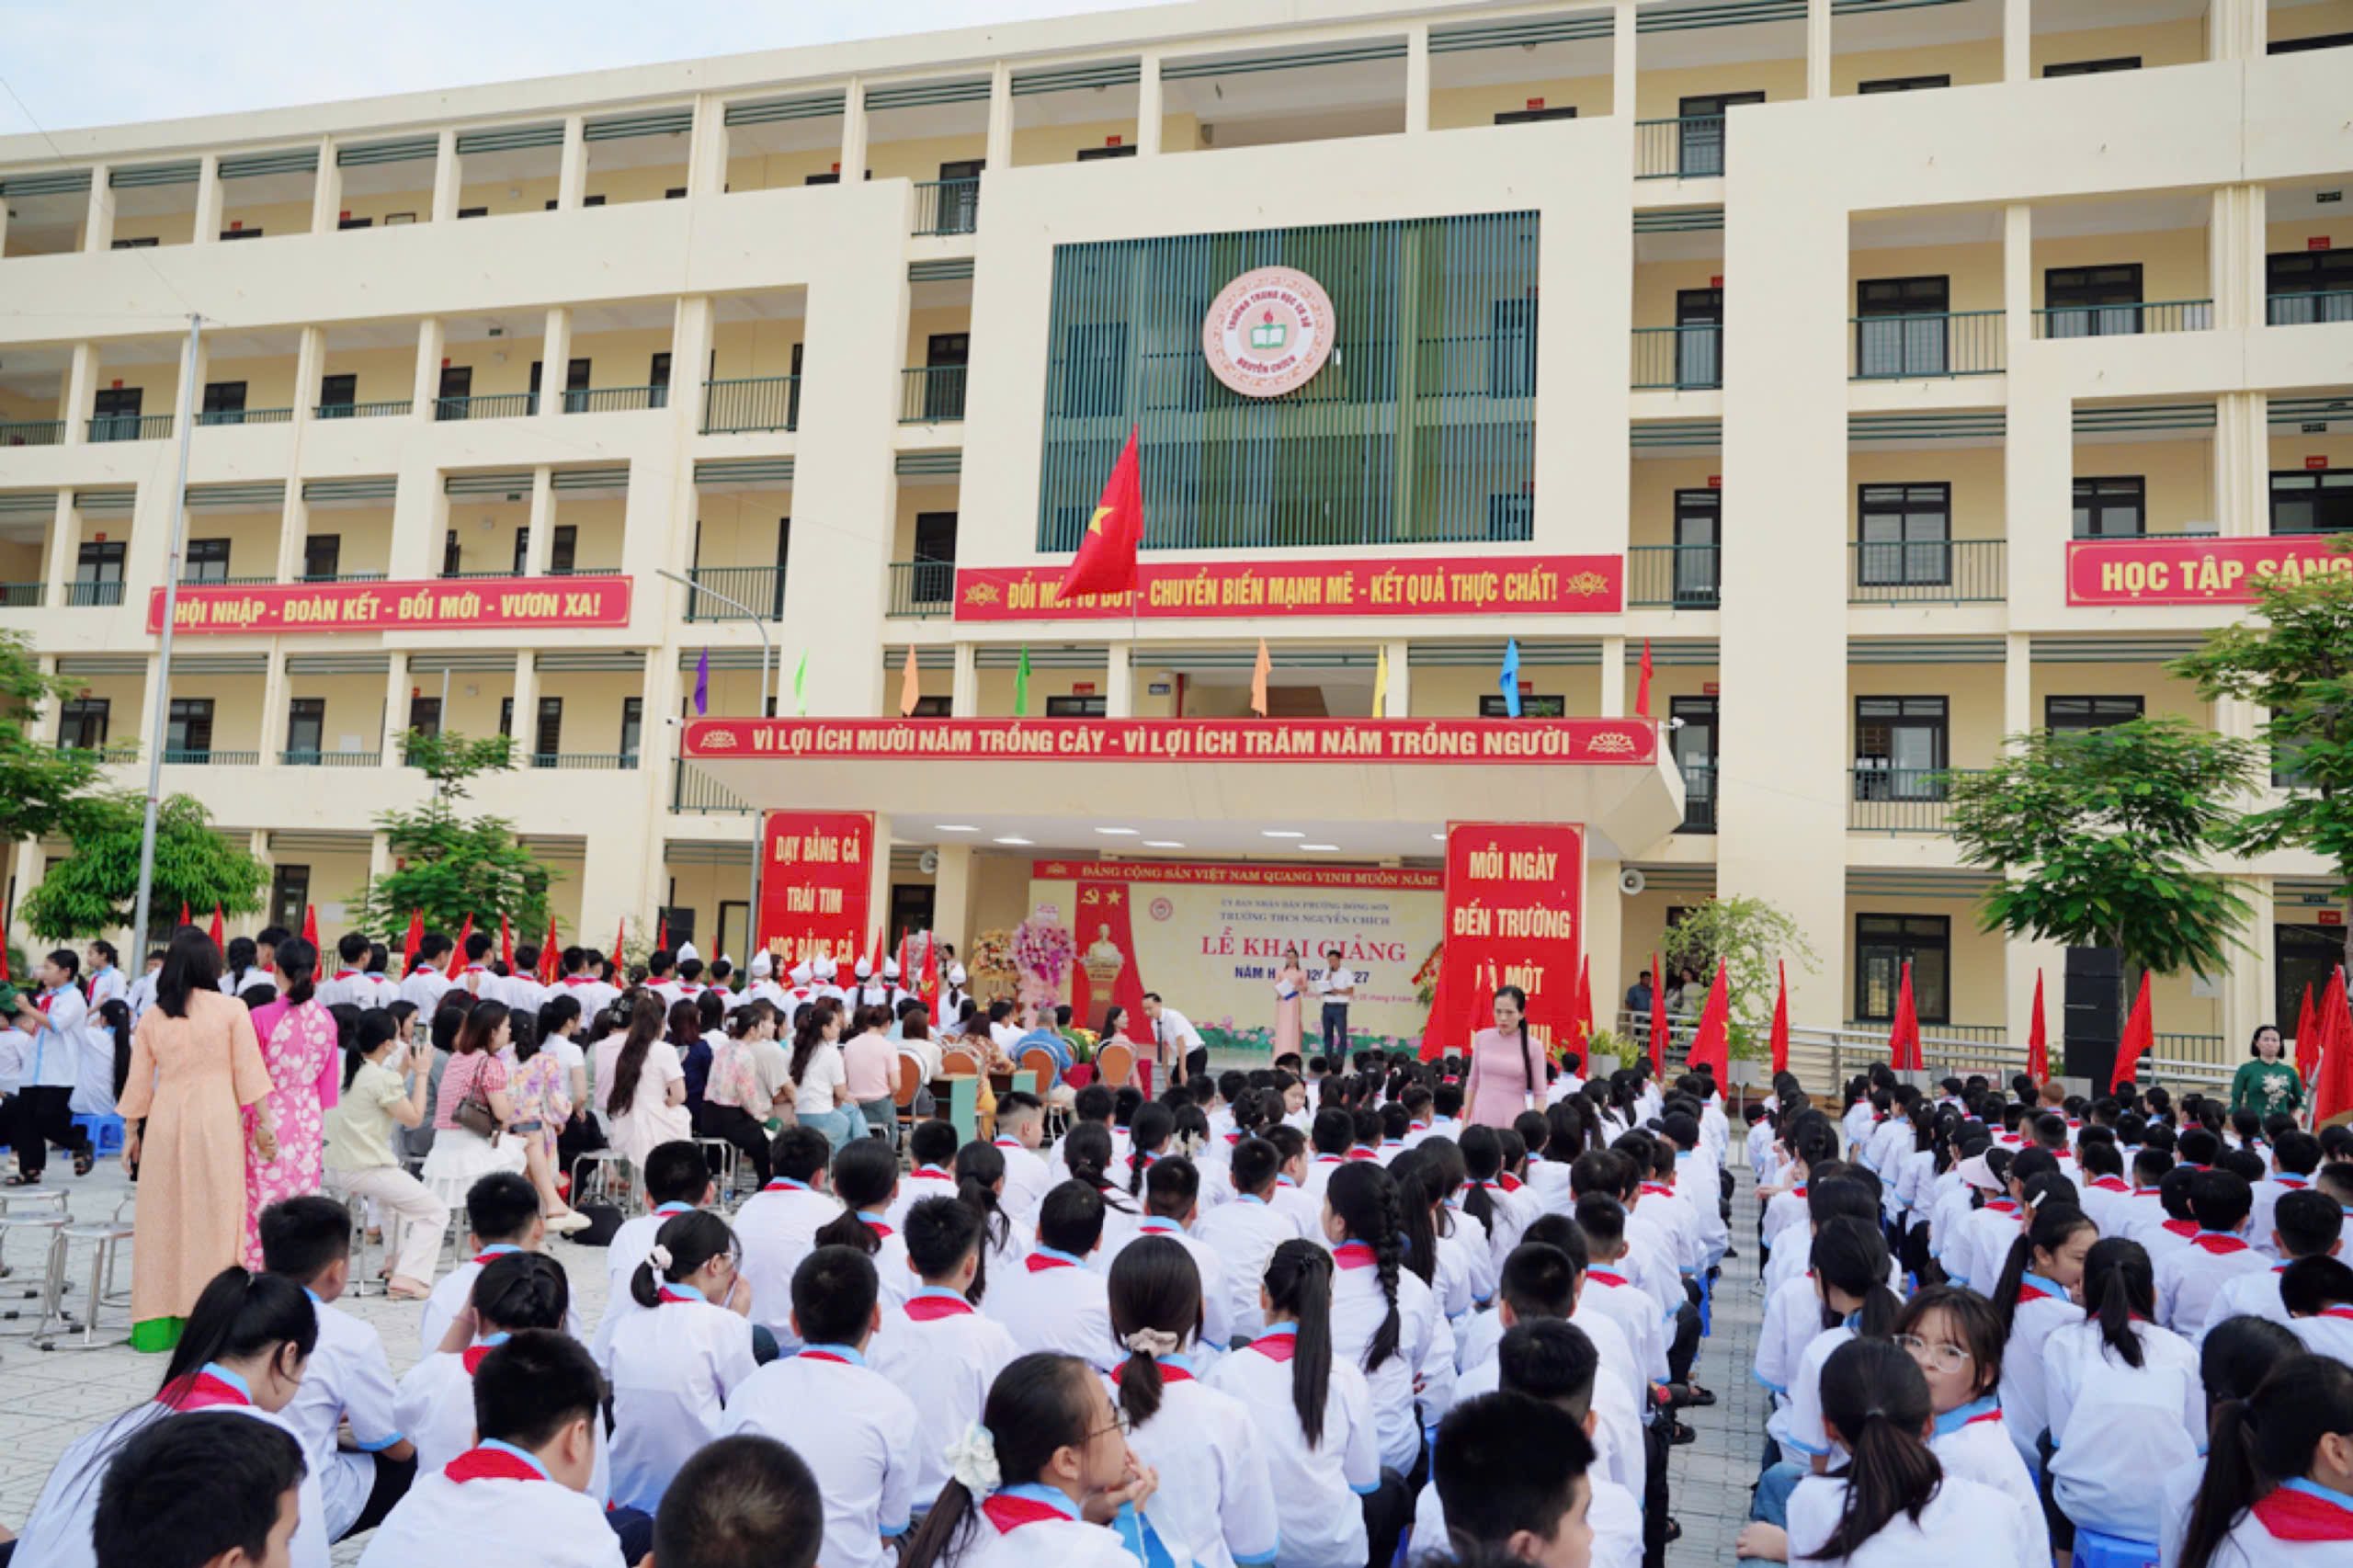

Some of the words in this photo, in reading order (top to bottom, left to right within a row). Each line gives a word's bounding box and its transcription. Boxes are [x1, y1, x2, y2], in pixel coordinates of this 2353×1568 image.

[1007, 570, 1036, 610] ĐỔI
[1150, 566, 1218, 608] CHUYỂN
[1222, 568, 1264, 605] BIẾN
[1267, 576, 1322, 609] MẠNH
[1370, 565, 1404, 604] KẾT
[1406, 565, 1446, 607] QUẢ
[1450, 570, 1498, 608] THỰC
[1504, 562, 1558, 603] CHẤT!
[2101, 561, 2169, 597] HỌC
[2179, 554, 2244, 596] TẬP
[174, 597, 206, 629] HỘI
[211, 597, 265, 628] NHẬP
[283, 595, 339, 622] ĐOÀN
[343, 591, 381, 621] KẾT
[398, 588, 434, 620] ĐỔI
[438, 591, 482, 619] MỚI
[499, 592, 561, 617] VƯƠN
[563, 592, 602, 618] XA!
[753, 725, 774, 751] VÌ
[778, 726, 813, 755] LỢI
[815, 724, 851, 751] ÍCH
[857, 723, 915, 752] MƯỜI
[920, 726, 972, 752] NĂM
[1058, 725, 1106, 753] CÂY
[1123, 725, 1145, 753] VÌ
[1150, 727, 1190, 757] LỢI
[1196, 725, 1236, 753] ÍCH
[1242, 726, 1315, 754] TRĂM
[1322, 726, 1381, 754] NĂM
[1483, 725, 1570, 755] NGƯỜI
[775, 835, 801, 866] DẠY
[1469, 841, 1504, 880] MỖI
[1509, 846, 1558, 881] NGÀY
[787, 881, 815, 913] TRÁI
[819, 888, 844, 915] TIM
[1453, 897, 1491, 936] ĐẾN
[1496, 902, 1571, 939] TRƯỜNG
[1243, 937, 1310, 959] KHAI
[1317, 933, 1406, 962] GIẢNG
[1235, 966, 1264, 980] NĂM
[1505, 958, 1545, 1001] MỘT
